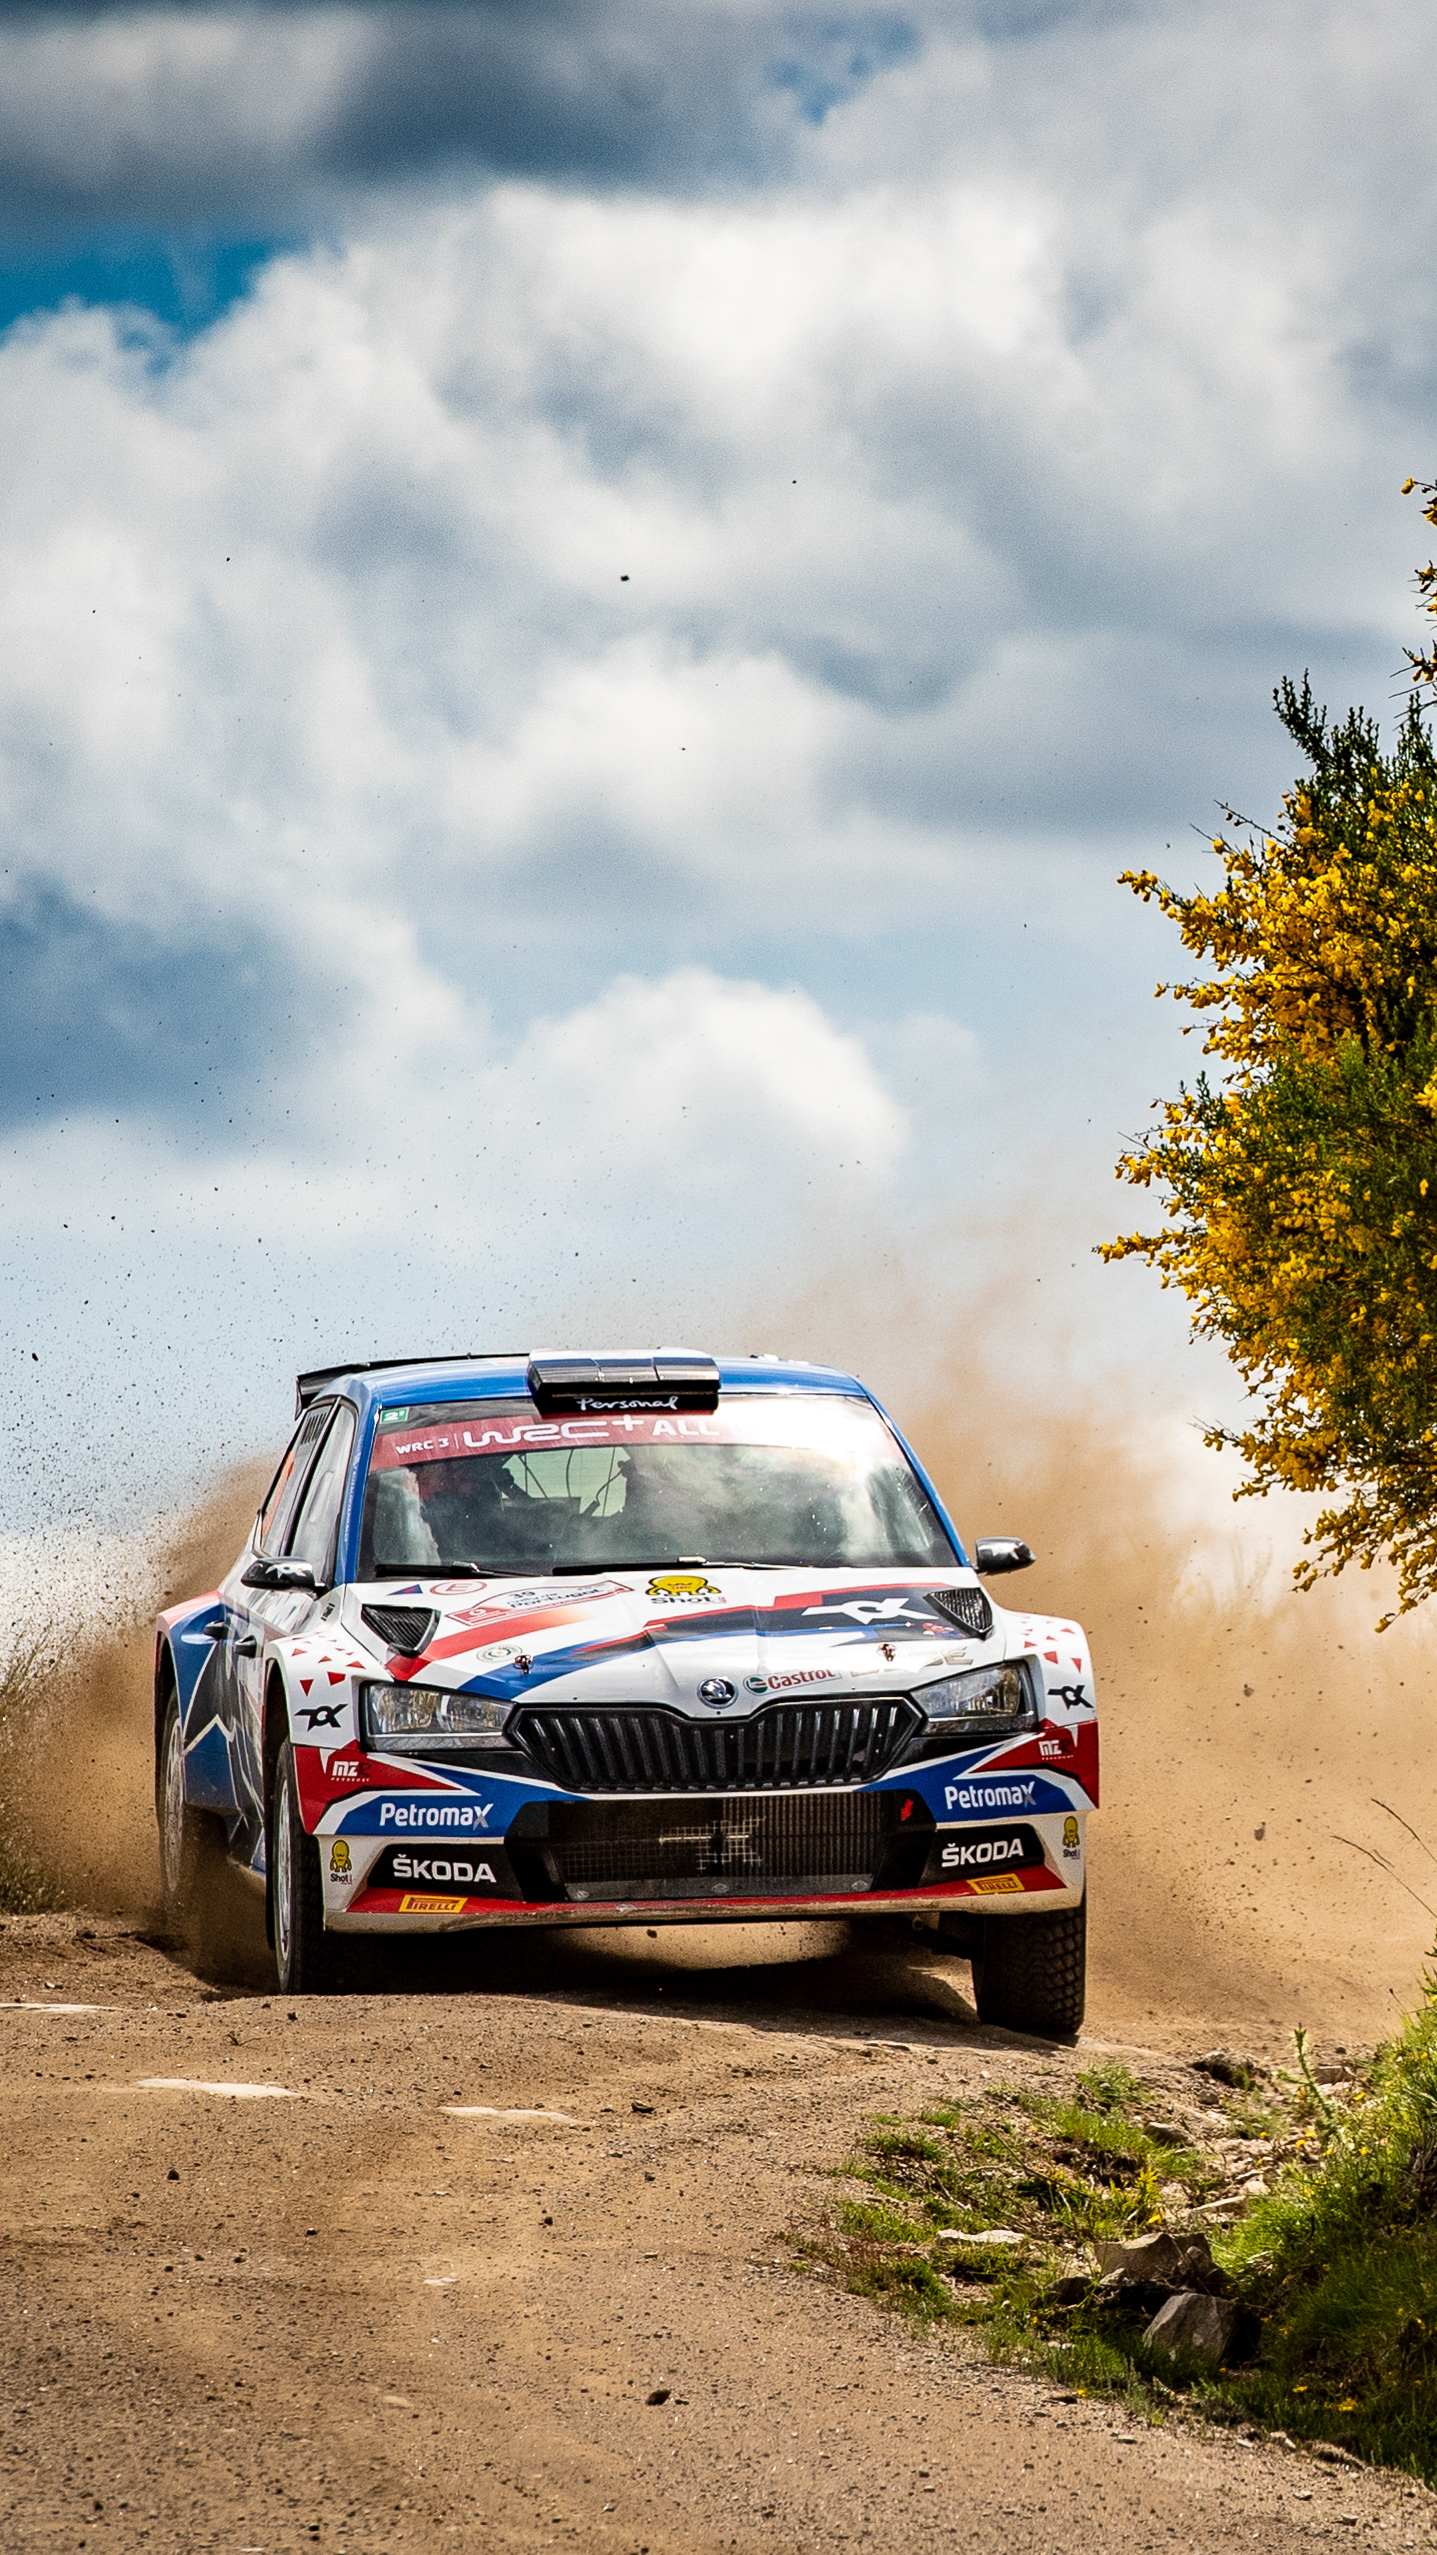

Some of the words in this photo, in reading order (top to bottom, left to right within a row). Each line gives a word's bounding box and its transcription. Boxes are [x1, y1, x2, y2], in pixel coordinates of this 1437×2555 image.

[576, 1396, 678, 1411] Personal
[396, 1440, 434, 1455] WRC
[438, 1438, 449, 1448] 3
[652, 1419, 719, 1437] ALL
[768, 1669, 835, 1690] Castrol
[941, 1838, 1024, 1868] ŠKODA
[393, 1854, 497, 1883] ŠKODA
[406, 1896, 460, 1910] PIRELLI
